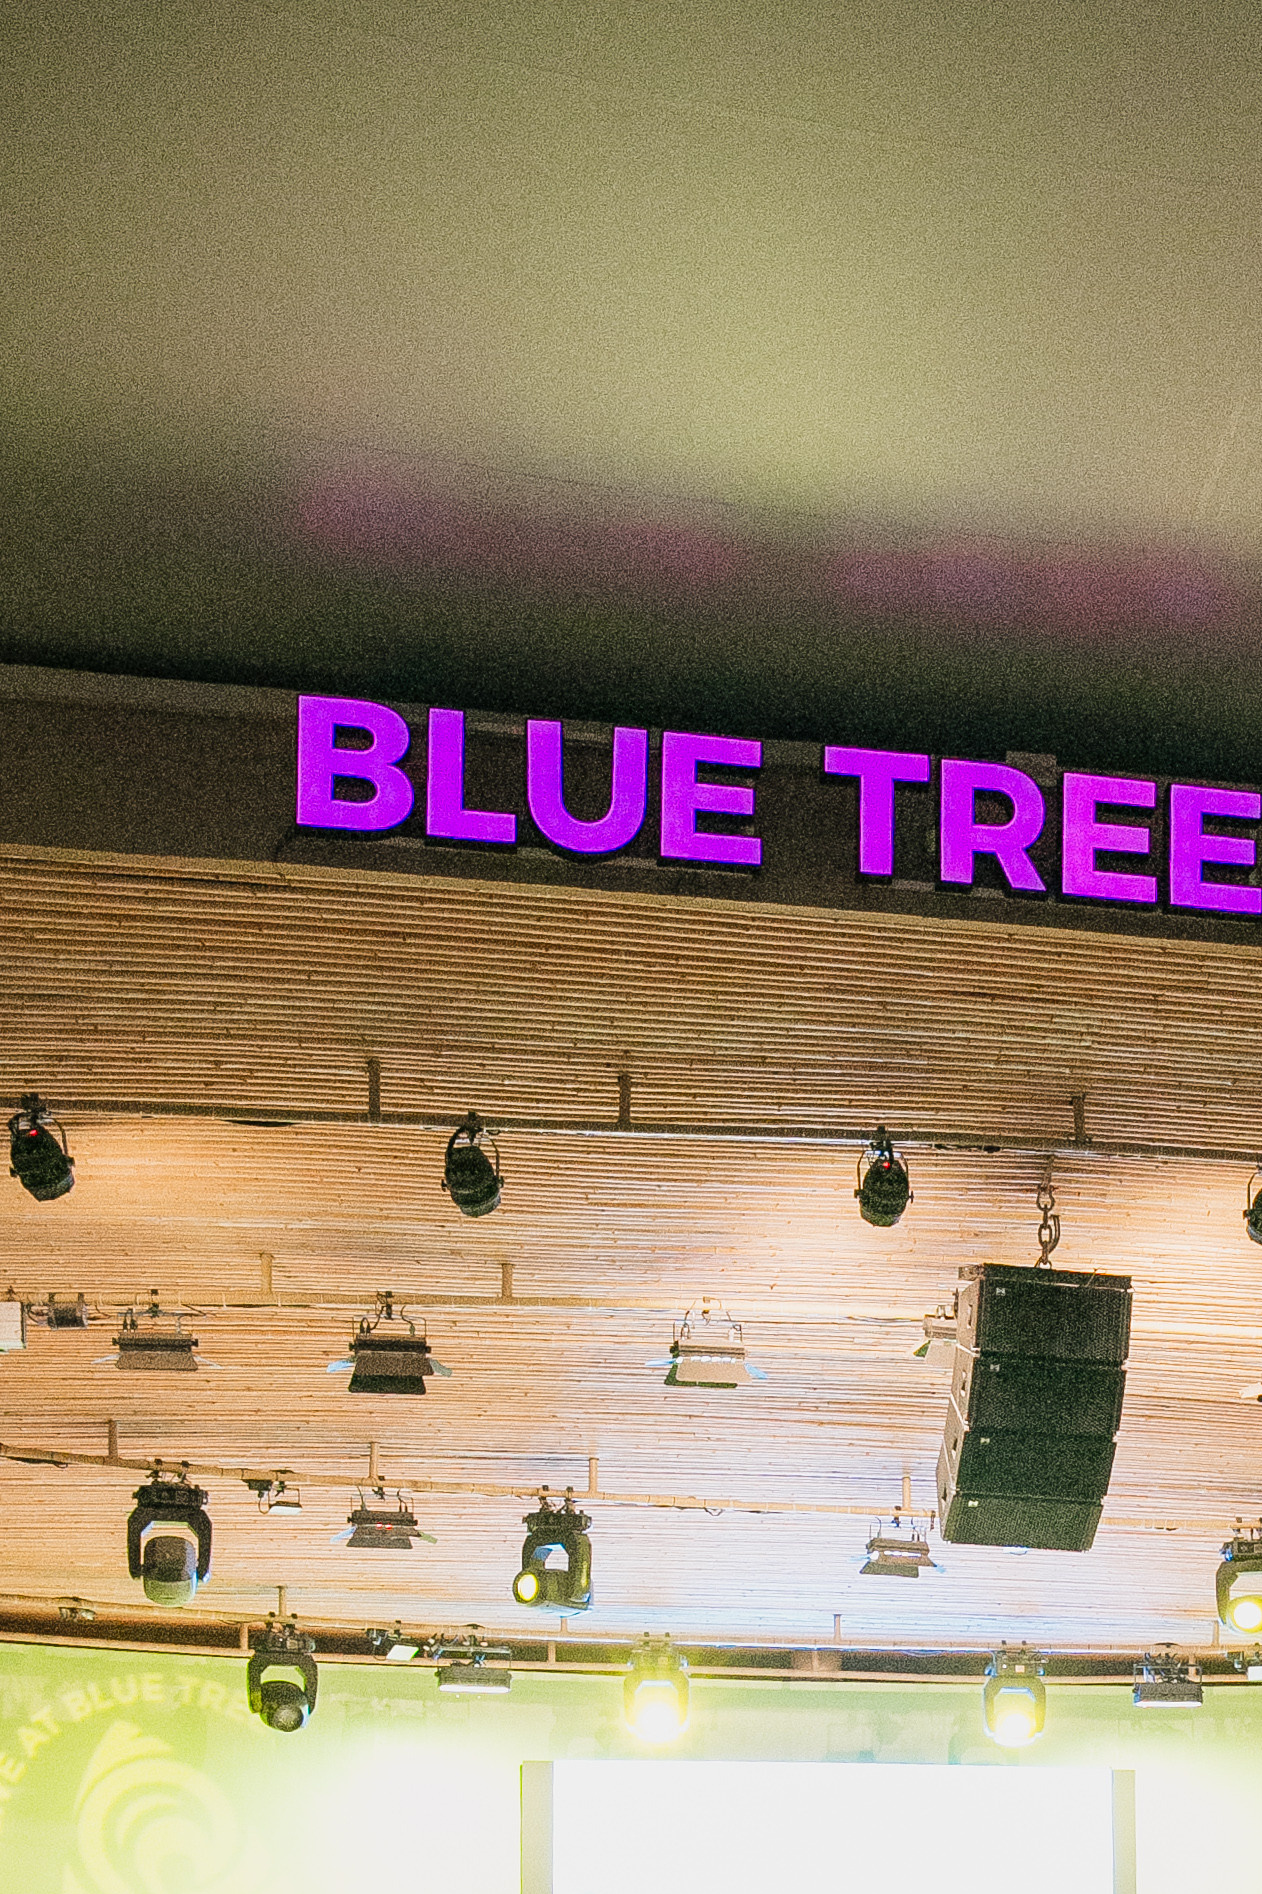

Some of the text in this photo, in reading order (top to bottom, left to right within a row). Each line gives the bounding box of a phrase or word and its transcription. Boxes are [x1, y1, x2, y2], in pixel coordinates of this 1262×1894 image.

[296, 695, 762, 866] BLUE
[827, 745, 1262, 913] TREE
[60, 1672, 166, 1723] BLUE
